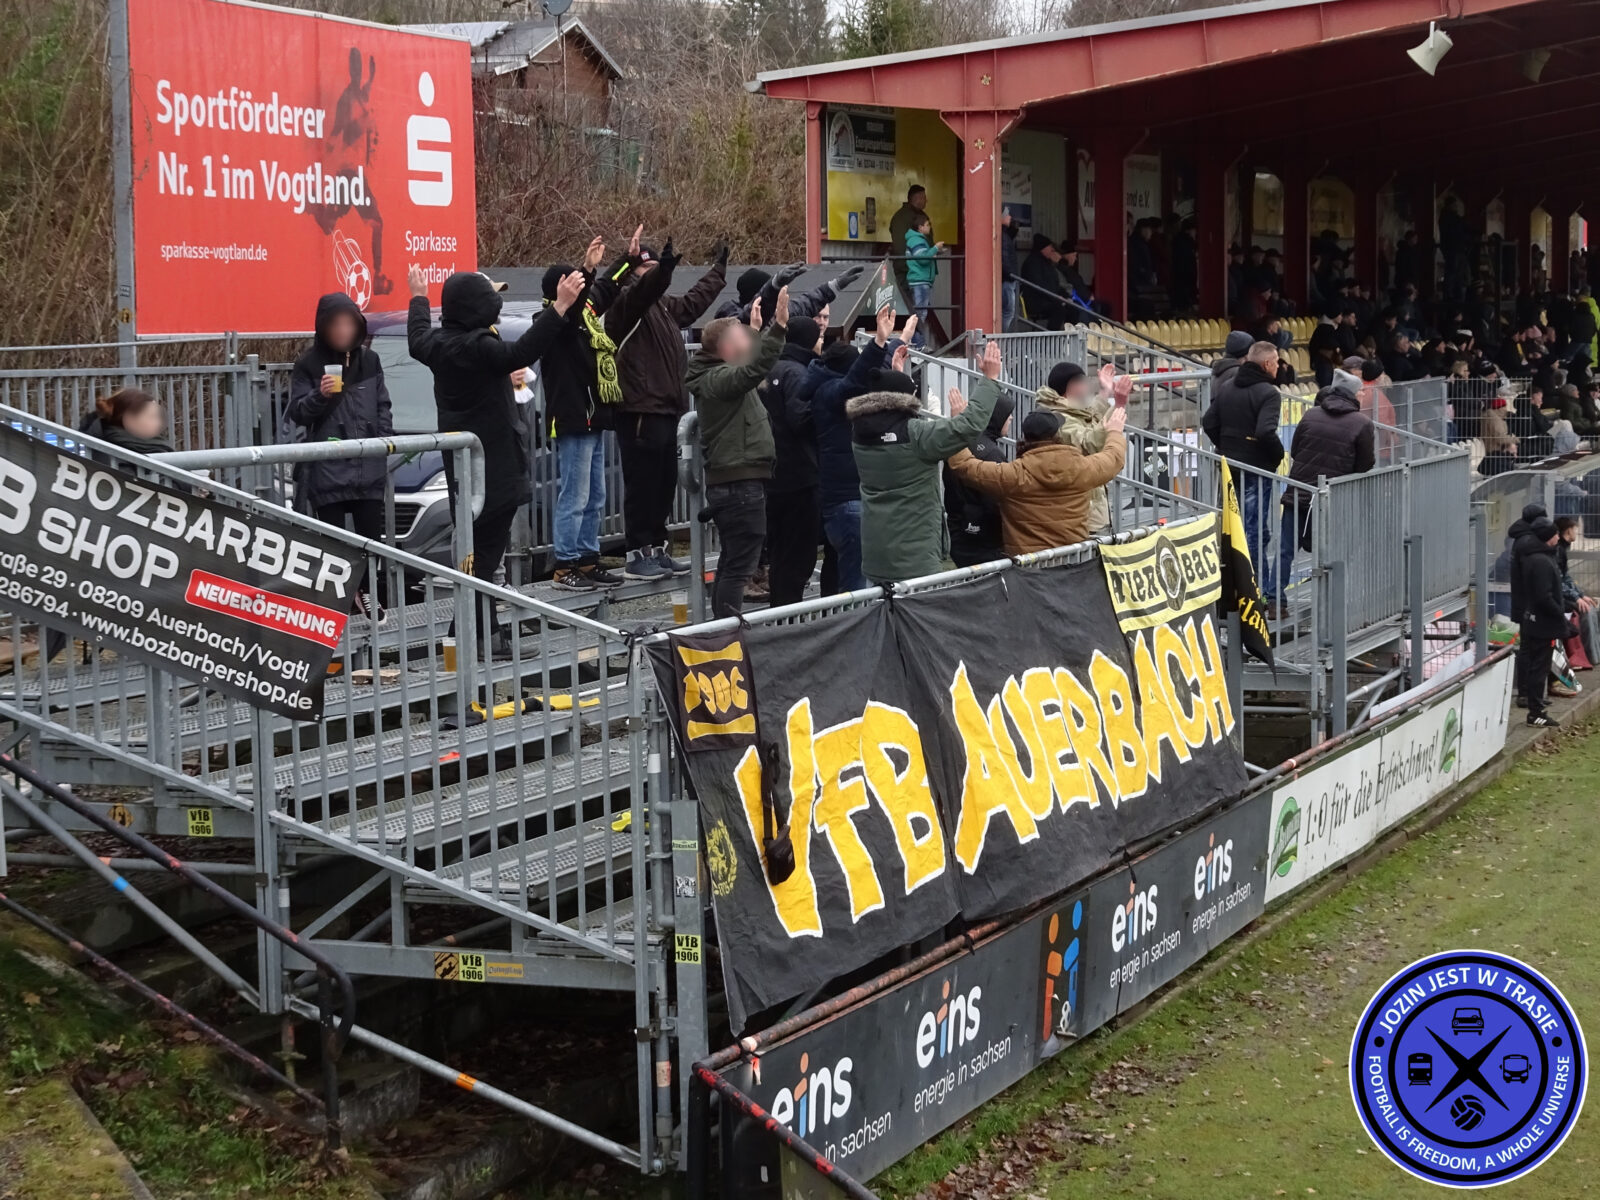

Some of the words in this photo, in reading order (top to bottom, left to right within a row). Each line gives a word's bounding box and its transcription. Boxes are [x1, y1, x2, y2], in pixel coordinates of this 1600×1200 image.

[156, 79, 325, 139] Sportförderer
[158, 151, 194, 197] Nr.
[202, 155, 217, 198] 1
[222, 154, 255, 200] im
[260, 160, 371, 214] Vogtland.
[161, 241, 268, 264] sparkasse-vogtland.de
[405, 230, 457, 256] Sparkasse
[38, 506, 180, 588] SHOP
[51, 453, 352, 599] BOZBARBER
[0, 551, 39, 579] aße
[40, 565, 68, 589] 29
[78, 580, 145, 619] 08209
[146, 607, 310, 684] Auerbach/Vogtl.
[195, 580, 335, 639] NEUERÖFFNUNG
[81, 610, 313, 711] www.bozbarbershop.de
[683, 666, 749, 714] 1906
[950, 614, 1235, 875] AUERBACH
[191, 810, 210, 822] VfB
[1304, 792, 1328, 846] 1:0
[1329, 782, 1351, 846] für
[1354, 769, 1372, 819] die
[1375, 728, 1439, 812] Erfrischung!
[191, 825, 212, 835] 1906
[1194, 832, 1233, 900] eins
[1112, 879, 1158, 952] eins
[1192, 902, 1217, 934] energie
[1218, 897, 1225, 917] in
[1225, 881, 1251, 912] sachsen
[461, 954, 482, 967] VfB
[676, 951, 699, 963] 1906
[677, 935, 698, 949] VfB
[1110, 954, 1140, 988] energie
[1141, 949, 1149, 969] in
[1151, 930, 1181, 963] sachsen
[461, 969, 483, 980] 1906
[916, 980, 982, 1069] eins
[771, 1052, 853, 1138] eins
[914, 1069, 955, 1113] energie
[958, 1060, 968, 1086] in
[970, 1036, 1011, 1077] sachsen
[825, 1140, 836, 1163] in
[841, 1111, 892, 1158] sachsen
